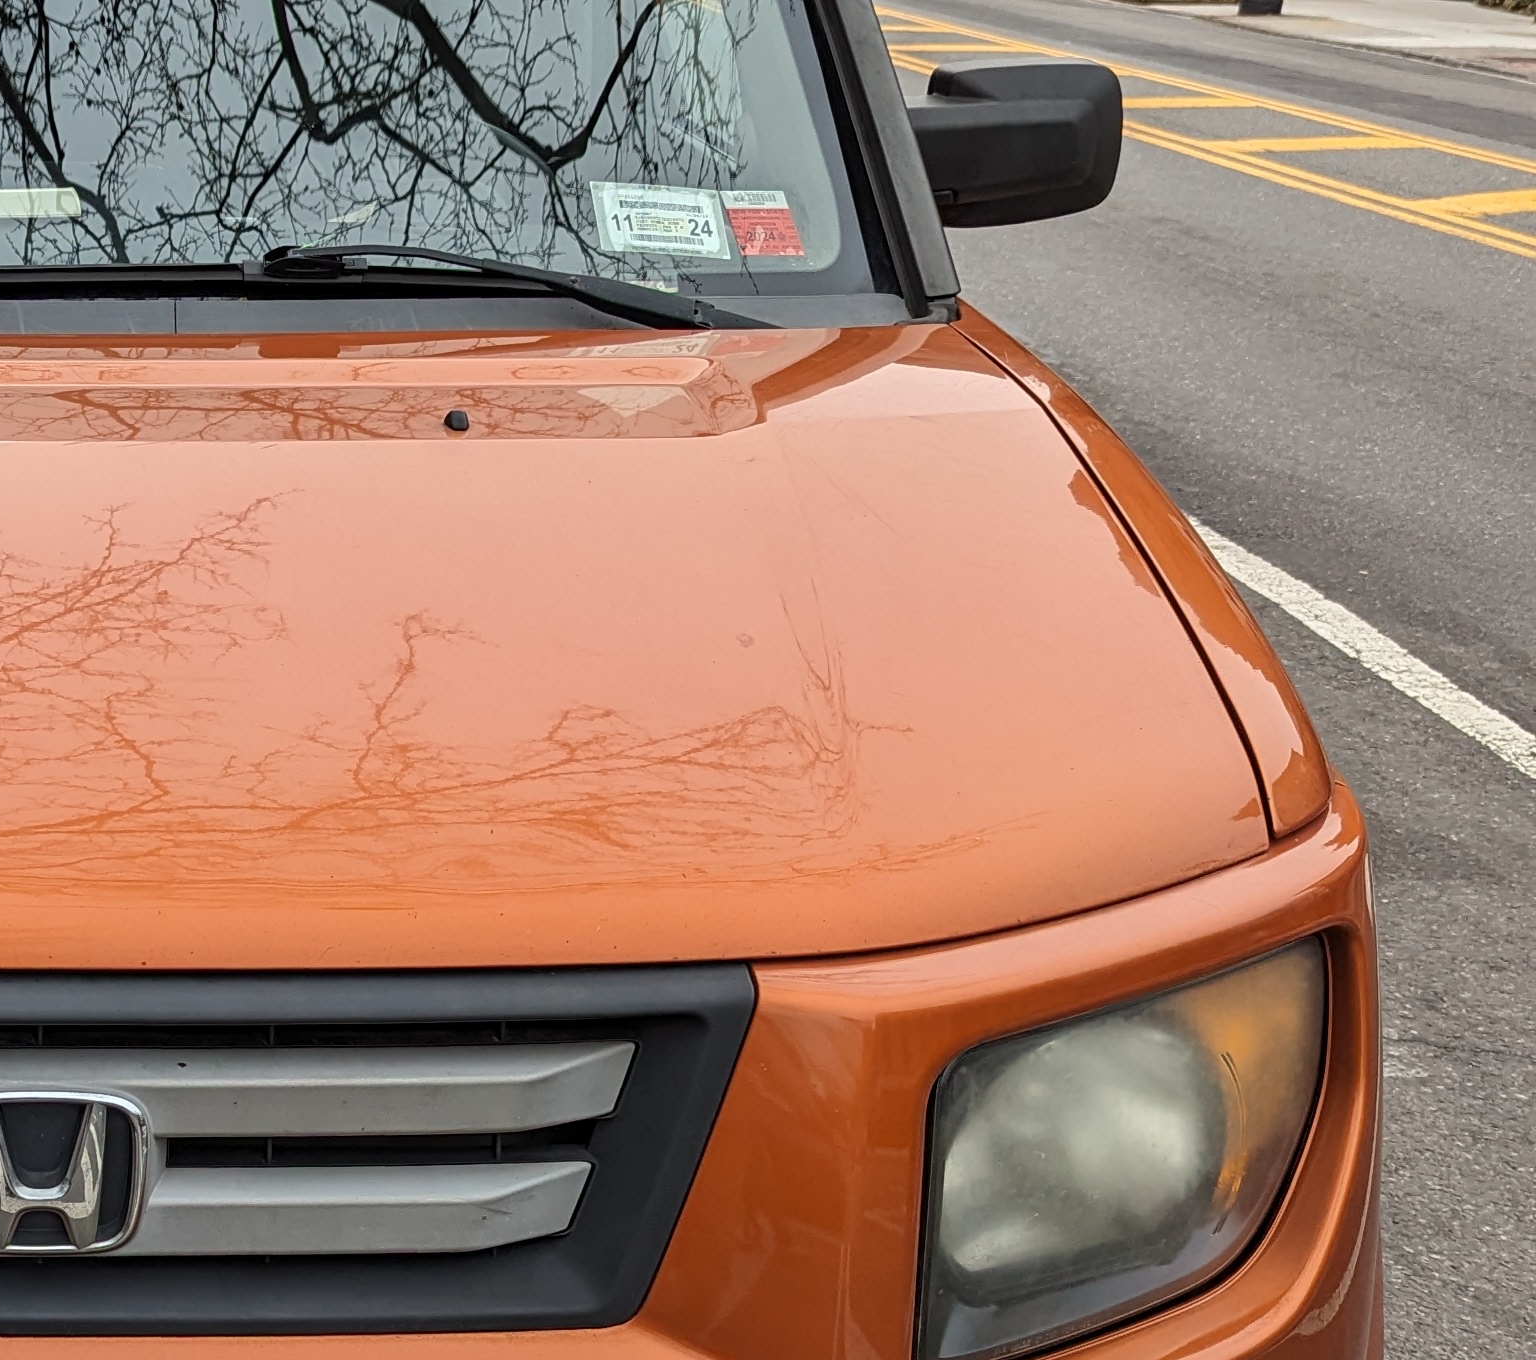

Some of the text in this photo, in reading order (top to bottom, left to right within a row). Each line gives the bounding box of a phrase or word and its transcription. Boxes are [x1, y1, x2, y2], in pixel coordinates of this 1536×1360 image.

[610, 213, 634, 232] 11
[687, 218, 714, 238] 24
[746, 230, 777, 242] 2024
